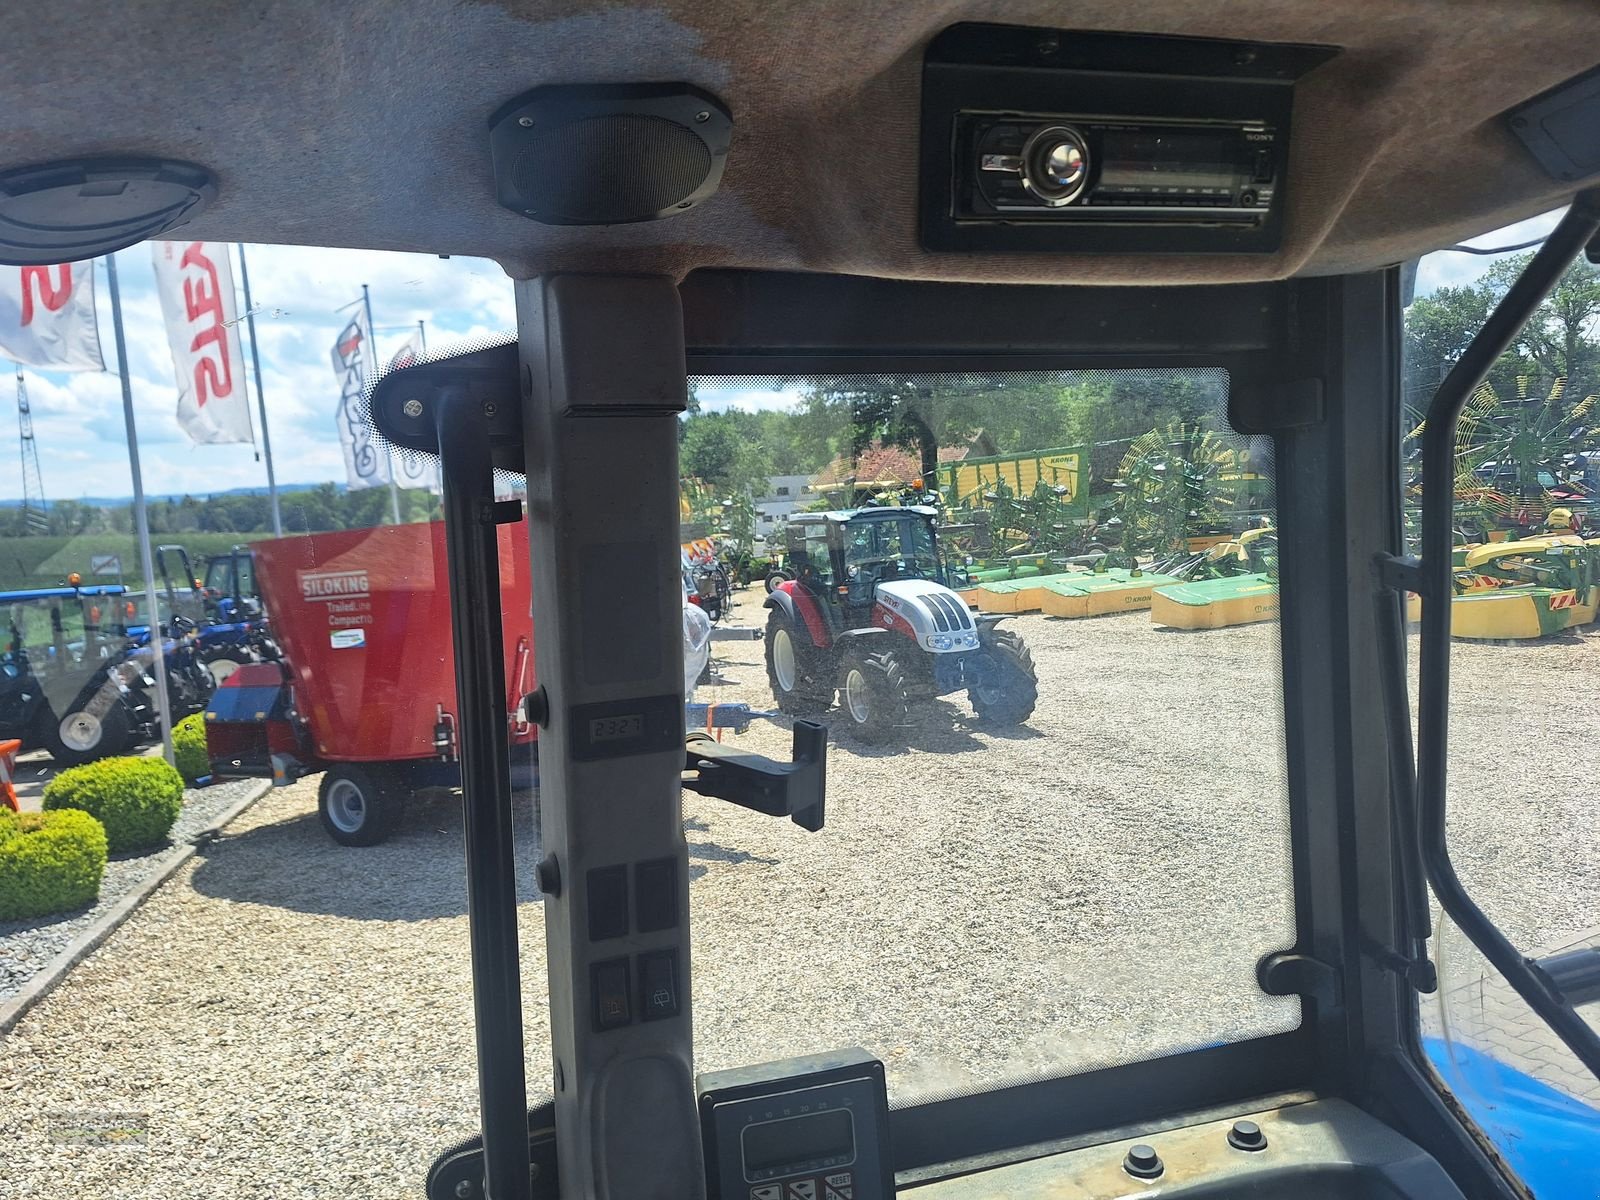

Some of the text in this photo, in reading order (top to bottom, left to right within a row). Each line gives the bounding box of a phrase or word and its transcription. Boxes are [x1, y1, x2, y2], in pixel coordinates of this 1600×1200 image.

[1246, 133, 1275, 142] SONY
[1050, 456, 1074, 465] KRONE
[304, 577, 369, 596] SILOKING
[1132, 595, 1152, 603] KRON
[831, 1174, 851, 1185] RESET
